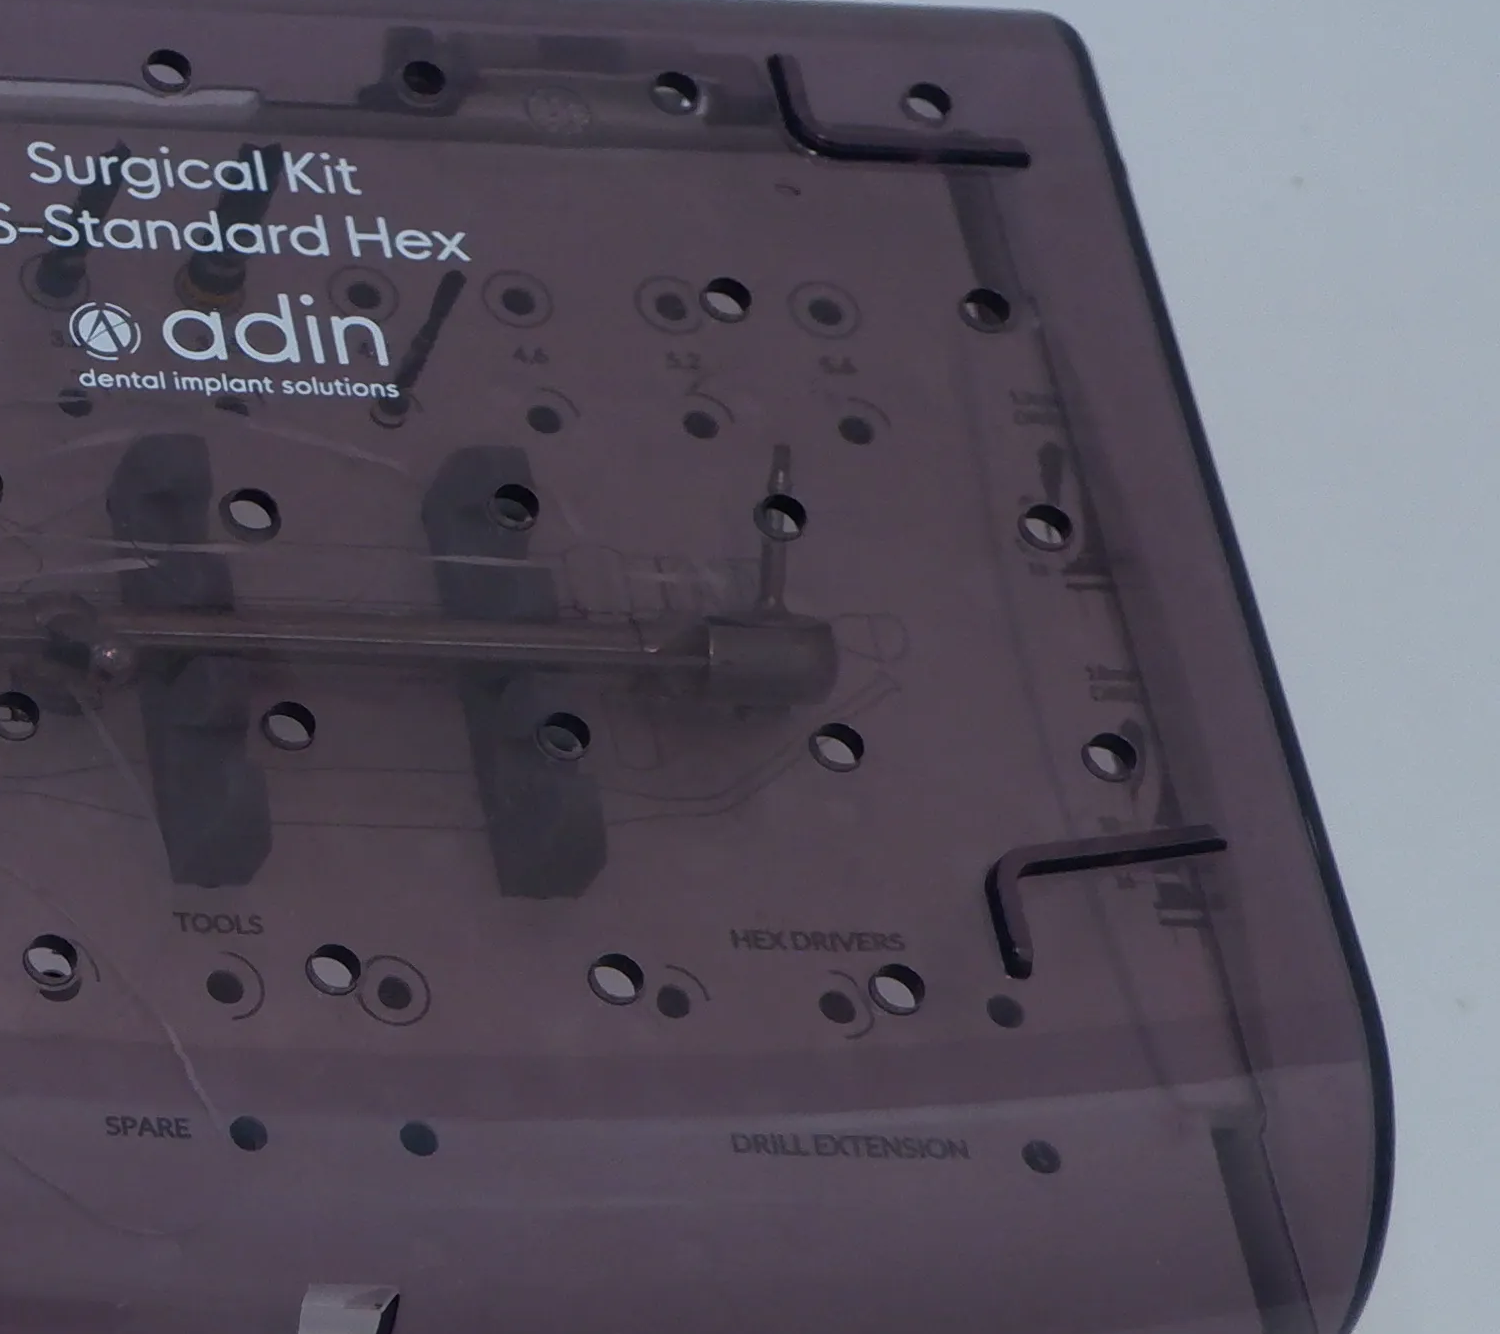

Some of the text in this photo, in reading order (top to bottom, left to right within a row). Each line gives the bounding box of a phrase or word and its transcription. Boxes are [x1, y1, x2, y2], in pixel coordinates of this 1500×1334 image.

[26, 140, 363, 199] Surgical Kit
[344, 215, 472, 263] Hex
[161, 292, 390, 367] adin
[78, 367, 400, 400] dental implant solutions
[172, 910, 265, 936] TOOLS
[729, 928, 907, 953] HEX DRIVERS
[104, 1114, 193, 1140] SPARE
[729, 1131, 972, 1161] DRILL EXTENSION
